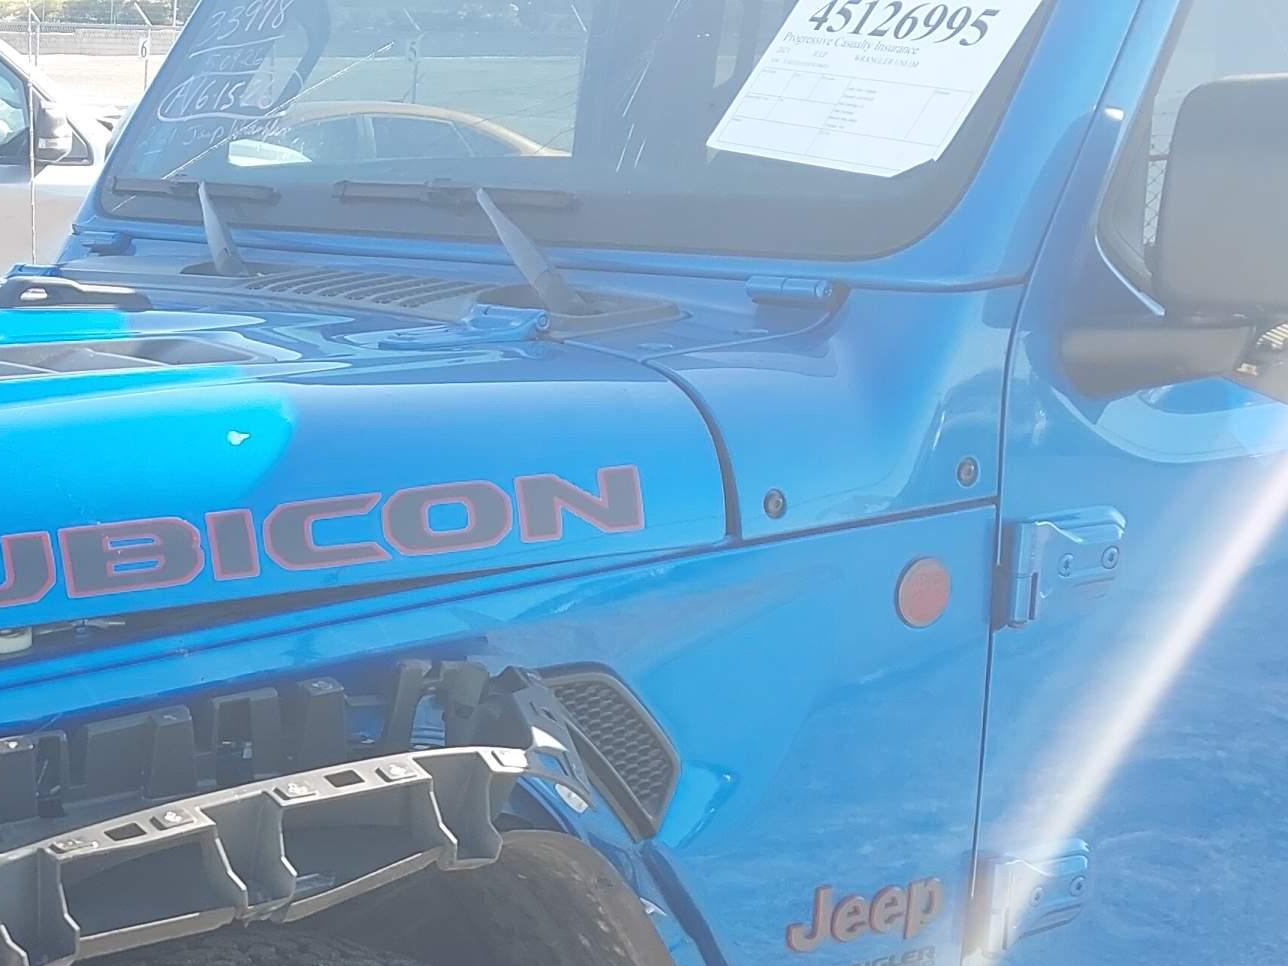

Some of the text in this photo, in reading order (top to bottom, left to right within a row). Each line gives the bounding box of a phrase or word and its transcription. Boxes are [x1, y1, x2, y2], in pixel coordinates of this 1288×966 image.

[808, 0, 1000, 46] 45126995
[140, 39, 147, 58] 6
[783, 31, 920, 56] Progressive Casualty Insurance
[786, 876, 943, 953] Jeep
